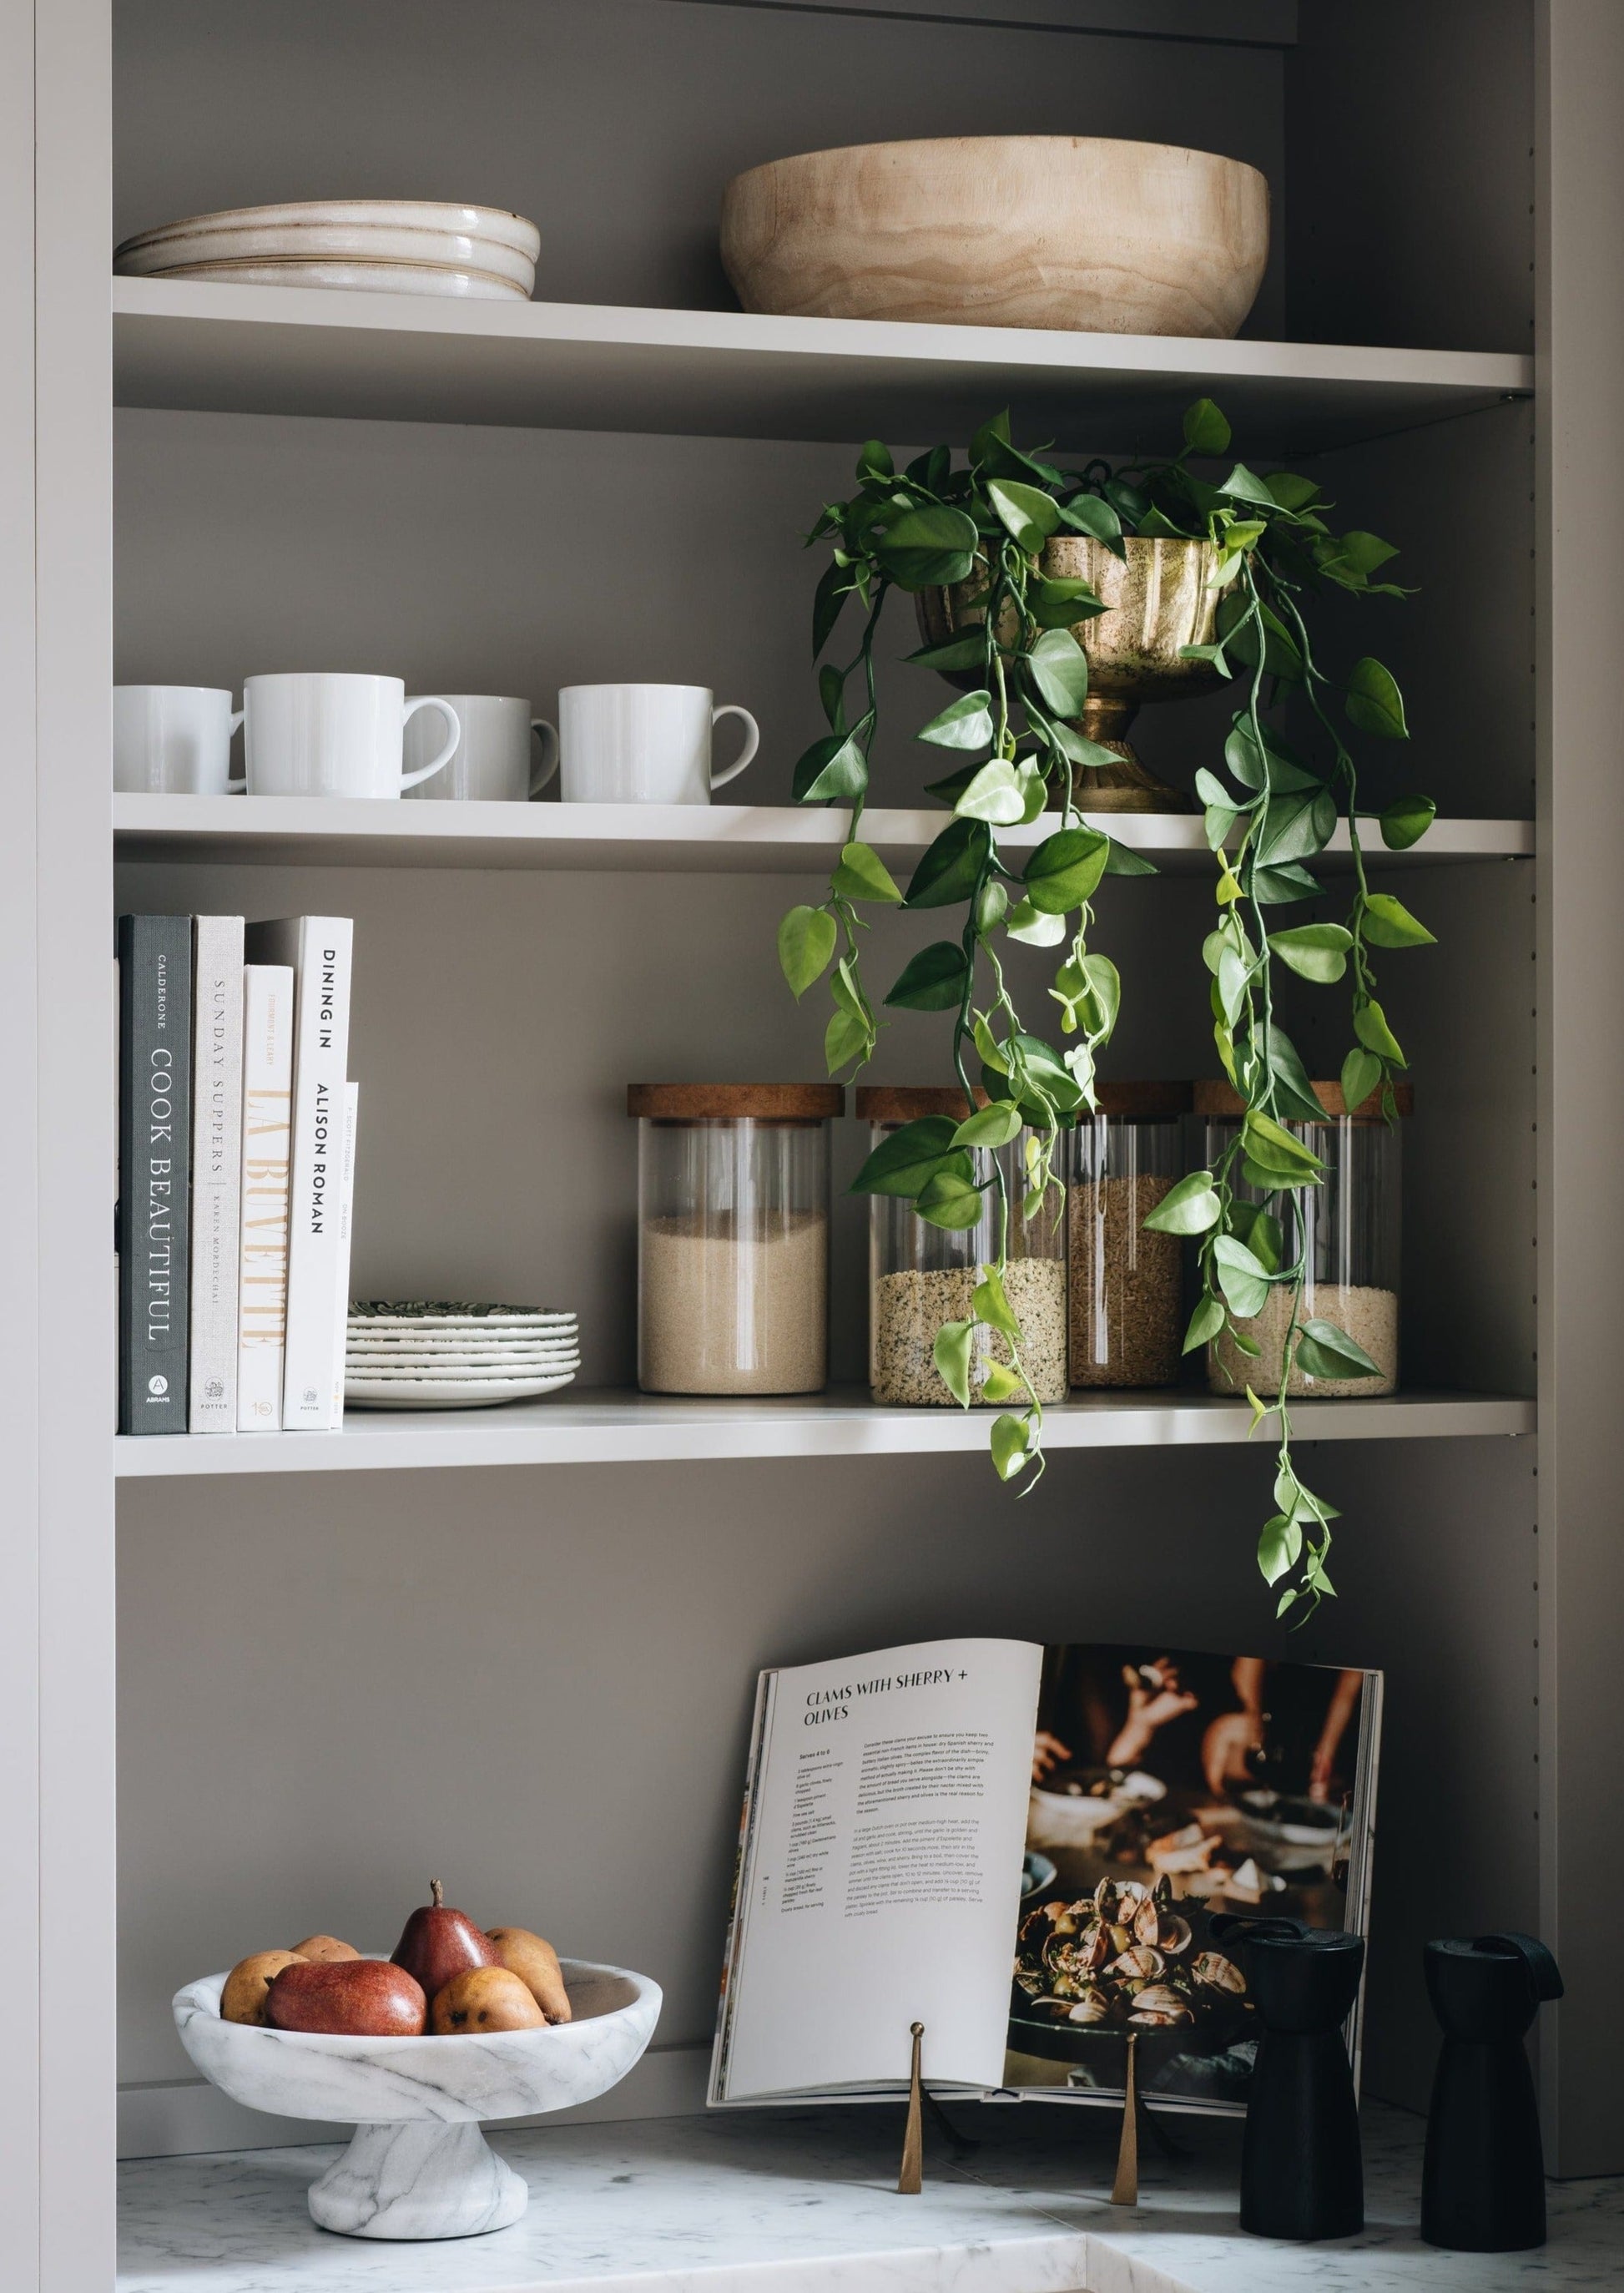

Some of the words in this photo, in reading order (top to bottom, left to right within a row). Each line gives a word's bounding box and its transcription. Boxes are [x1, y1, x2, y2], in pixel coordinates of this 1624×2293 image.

[157, 954, 167, 1029] CALDERONE
[320, 949, 335, 1020] DINING
[213, 980, 225, 1068] SUNDAY
[266, 1043, 275, 1066] LEAHY
[320, 1029, 332, 1048] IN
[150, 1048, 172, 1144] COOK
[211, 1080, 224, 1172] SUPPERS
[246, 1090, 290, 1135] LA
[314, 1083, 329, 1154] ALISON
[311, 1164, 325, 1234] ROMAN
[149, 1158, 172, 1340] BEAUTIFUL
[212, 1237, 220, 1304] MORDECHAI
[241, 1159, 290, 1348] BUVETTE
[804, 1705, 849, 1725] OLIVES
[807, 1684, 852, 1706] CLAMS
[856, 1677, 891, 1695] WITH
[895, 1669, 955, 1689] SHERRY
[958, 1669, 968, 1680] +
[799, 1751, 815, 1760] Serves
